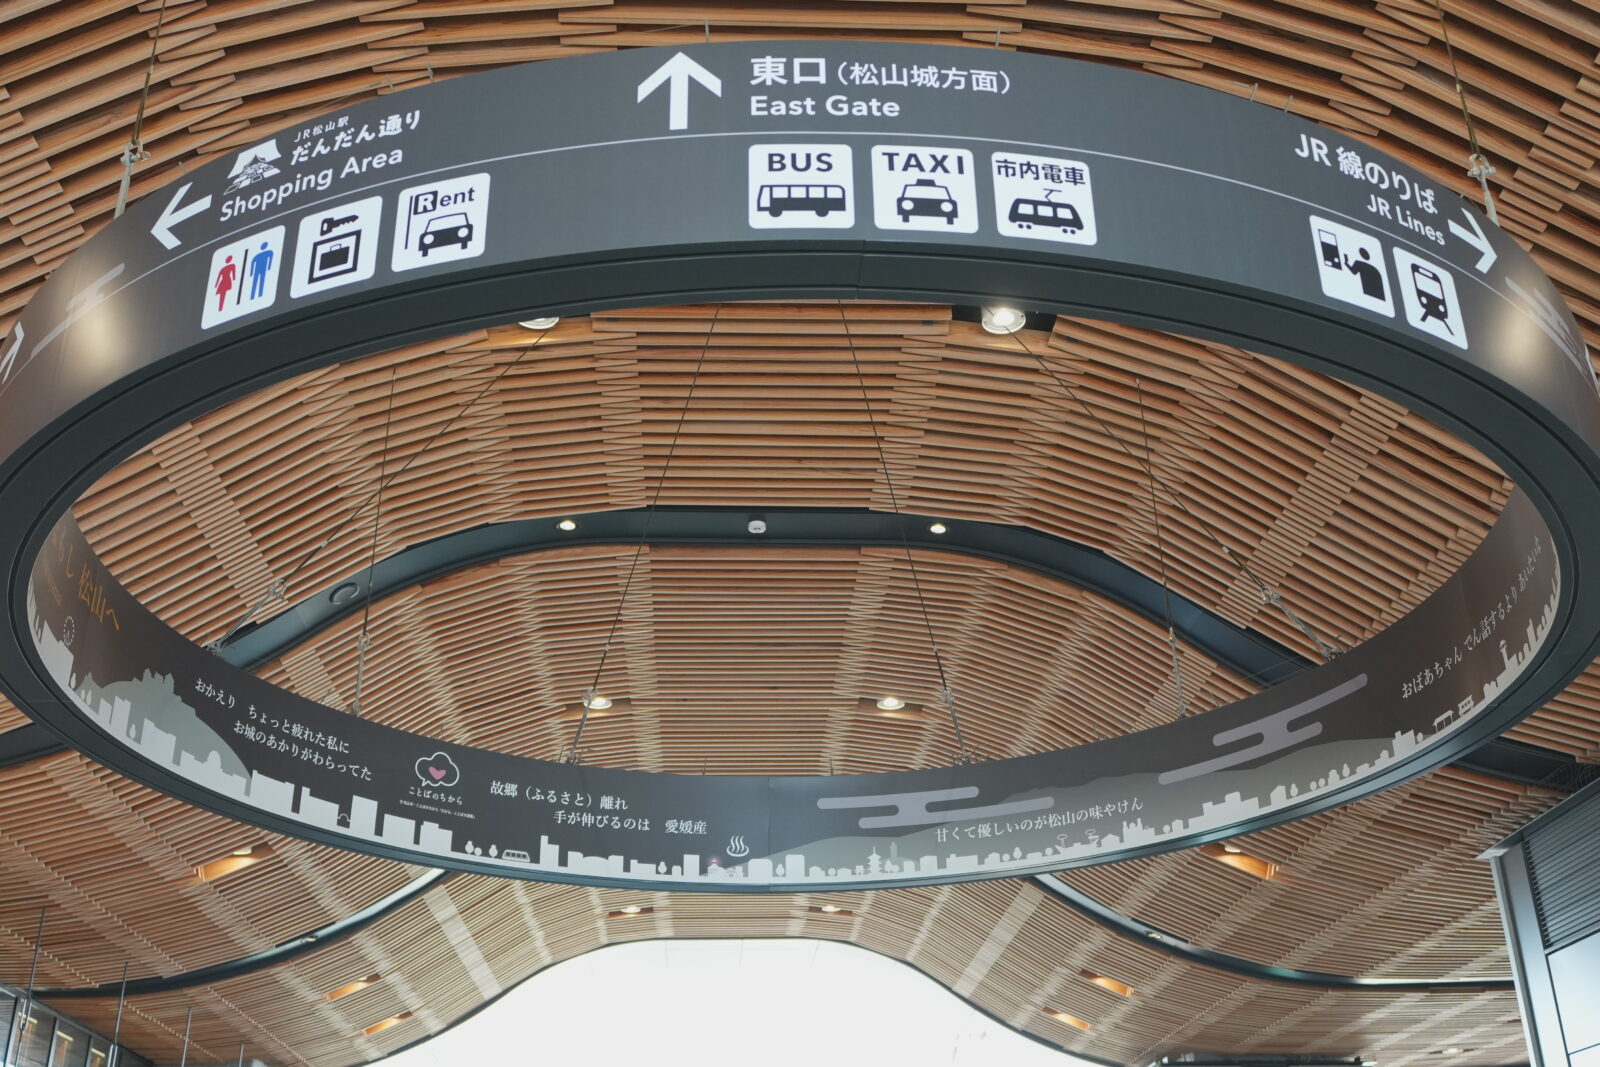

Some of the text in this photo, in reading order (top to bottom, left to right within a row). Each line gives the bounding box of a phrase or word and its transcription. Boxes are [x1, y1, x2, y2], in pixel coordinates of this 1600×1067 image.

[750, 94, 900, 117] East Gate
[290, 109, 421, 166] だんだん通り
[294, 116, 349, 143] JR松山駅
[767, 152, 833, 172] BUS
[882, 152, 965, 175] TAXI
[995, 159, 1087, 186] 市内電車
[219, 149, 403, 222] Shopping Area
[413, 186, 476, 216] Rent
[1367, 194, 1446, 246] JR Lines
[1402, 645, 1463, 699] おばあちゃん
[1464, 586, 1518, 651] でん話するより
[195, 678, 350, 754] おかえり ちょっと疲れた私に
[233, 720, 373, 782] お城のあかりがわらってた
[408, 786, 463, 806] ことばのちから
[553, 810, 708, 835] 手が伸びるのは 愛媛産
[934, 797, 1144, 843] 甘くて優しいのが松山の味やけん
